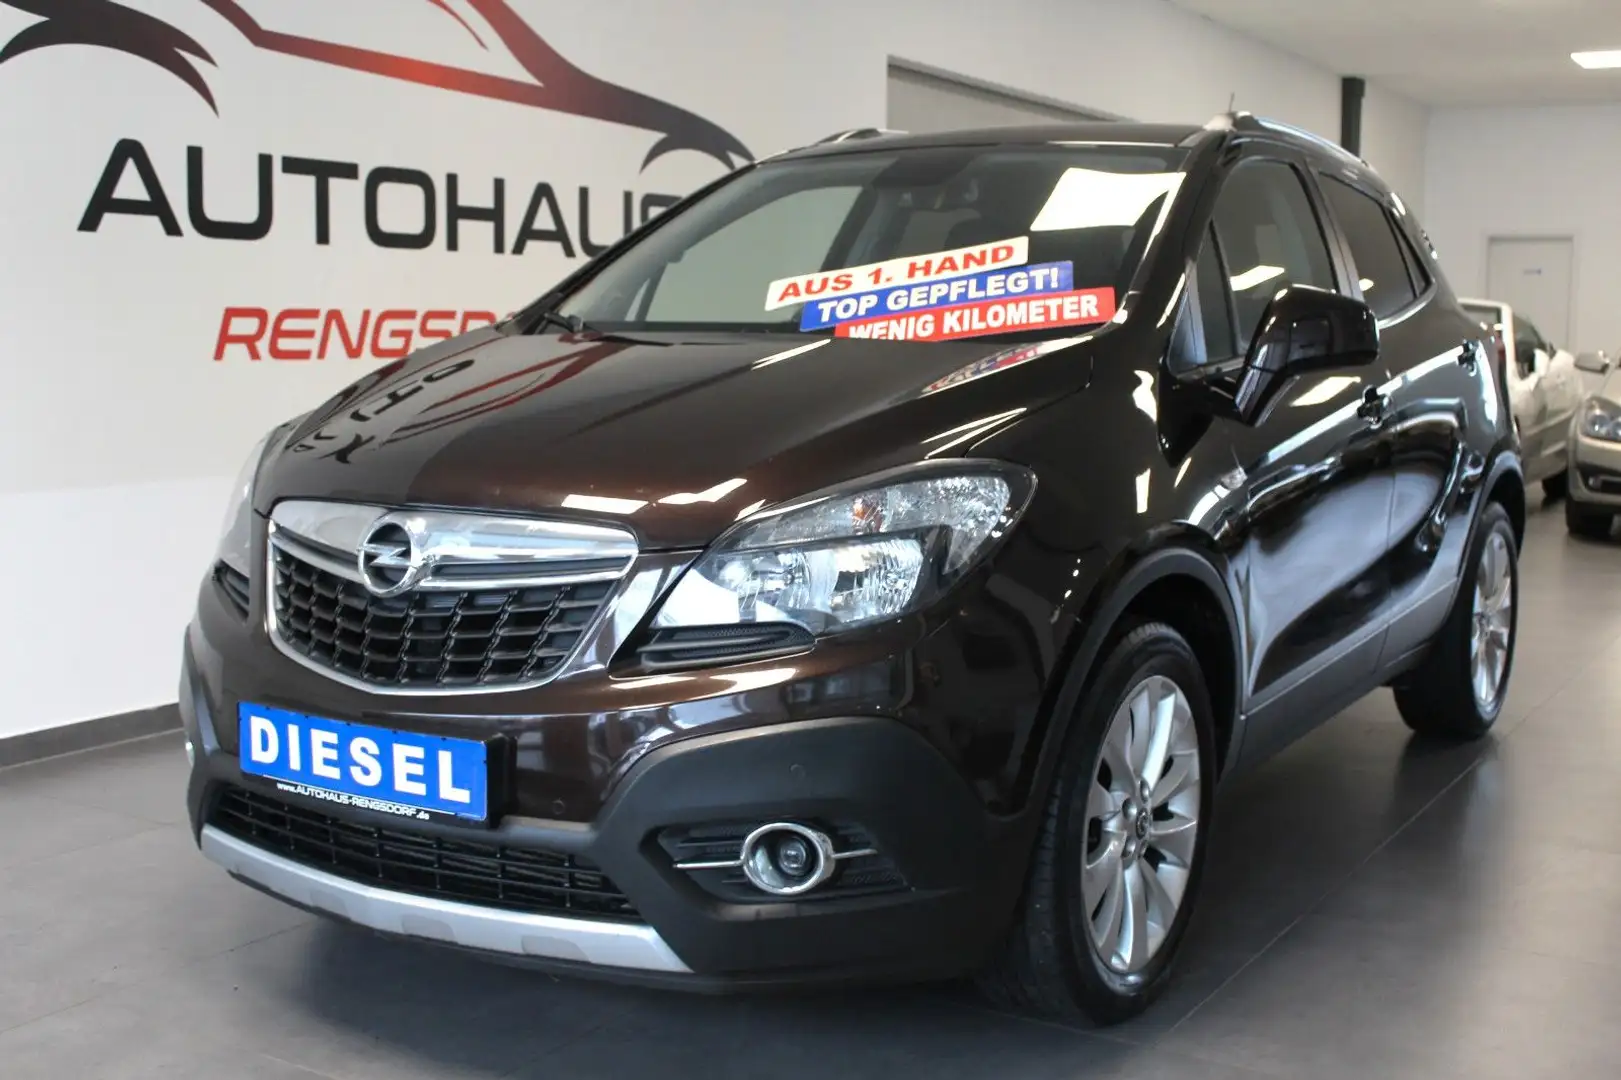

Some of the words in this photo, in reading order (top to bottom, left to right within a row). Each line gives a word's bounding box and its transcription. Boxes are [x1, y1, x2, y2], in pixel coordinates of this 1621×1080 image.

[777, 273, 853, 302] AUS
[867, 267, 893, 285] 1.
[907, 245, 1015, 280] HAND
[818, 297, 878, 323] TOP
[887, 267, 1059, 312] GEPFLEGT!
[213, 306, 500, 361] RENGS
[849, 314, 935, 341] WENIG
[943, 294, 1099, 334] KILOMETER
[250, 715, 471, 804] DIESEL
